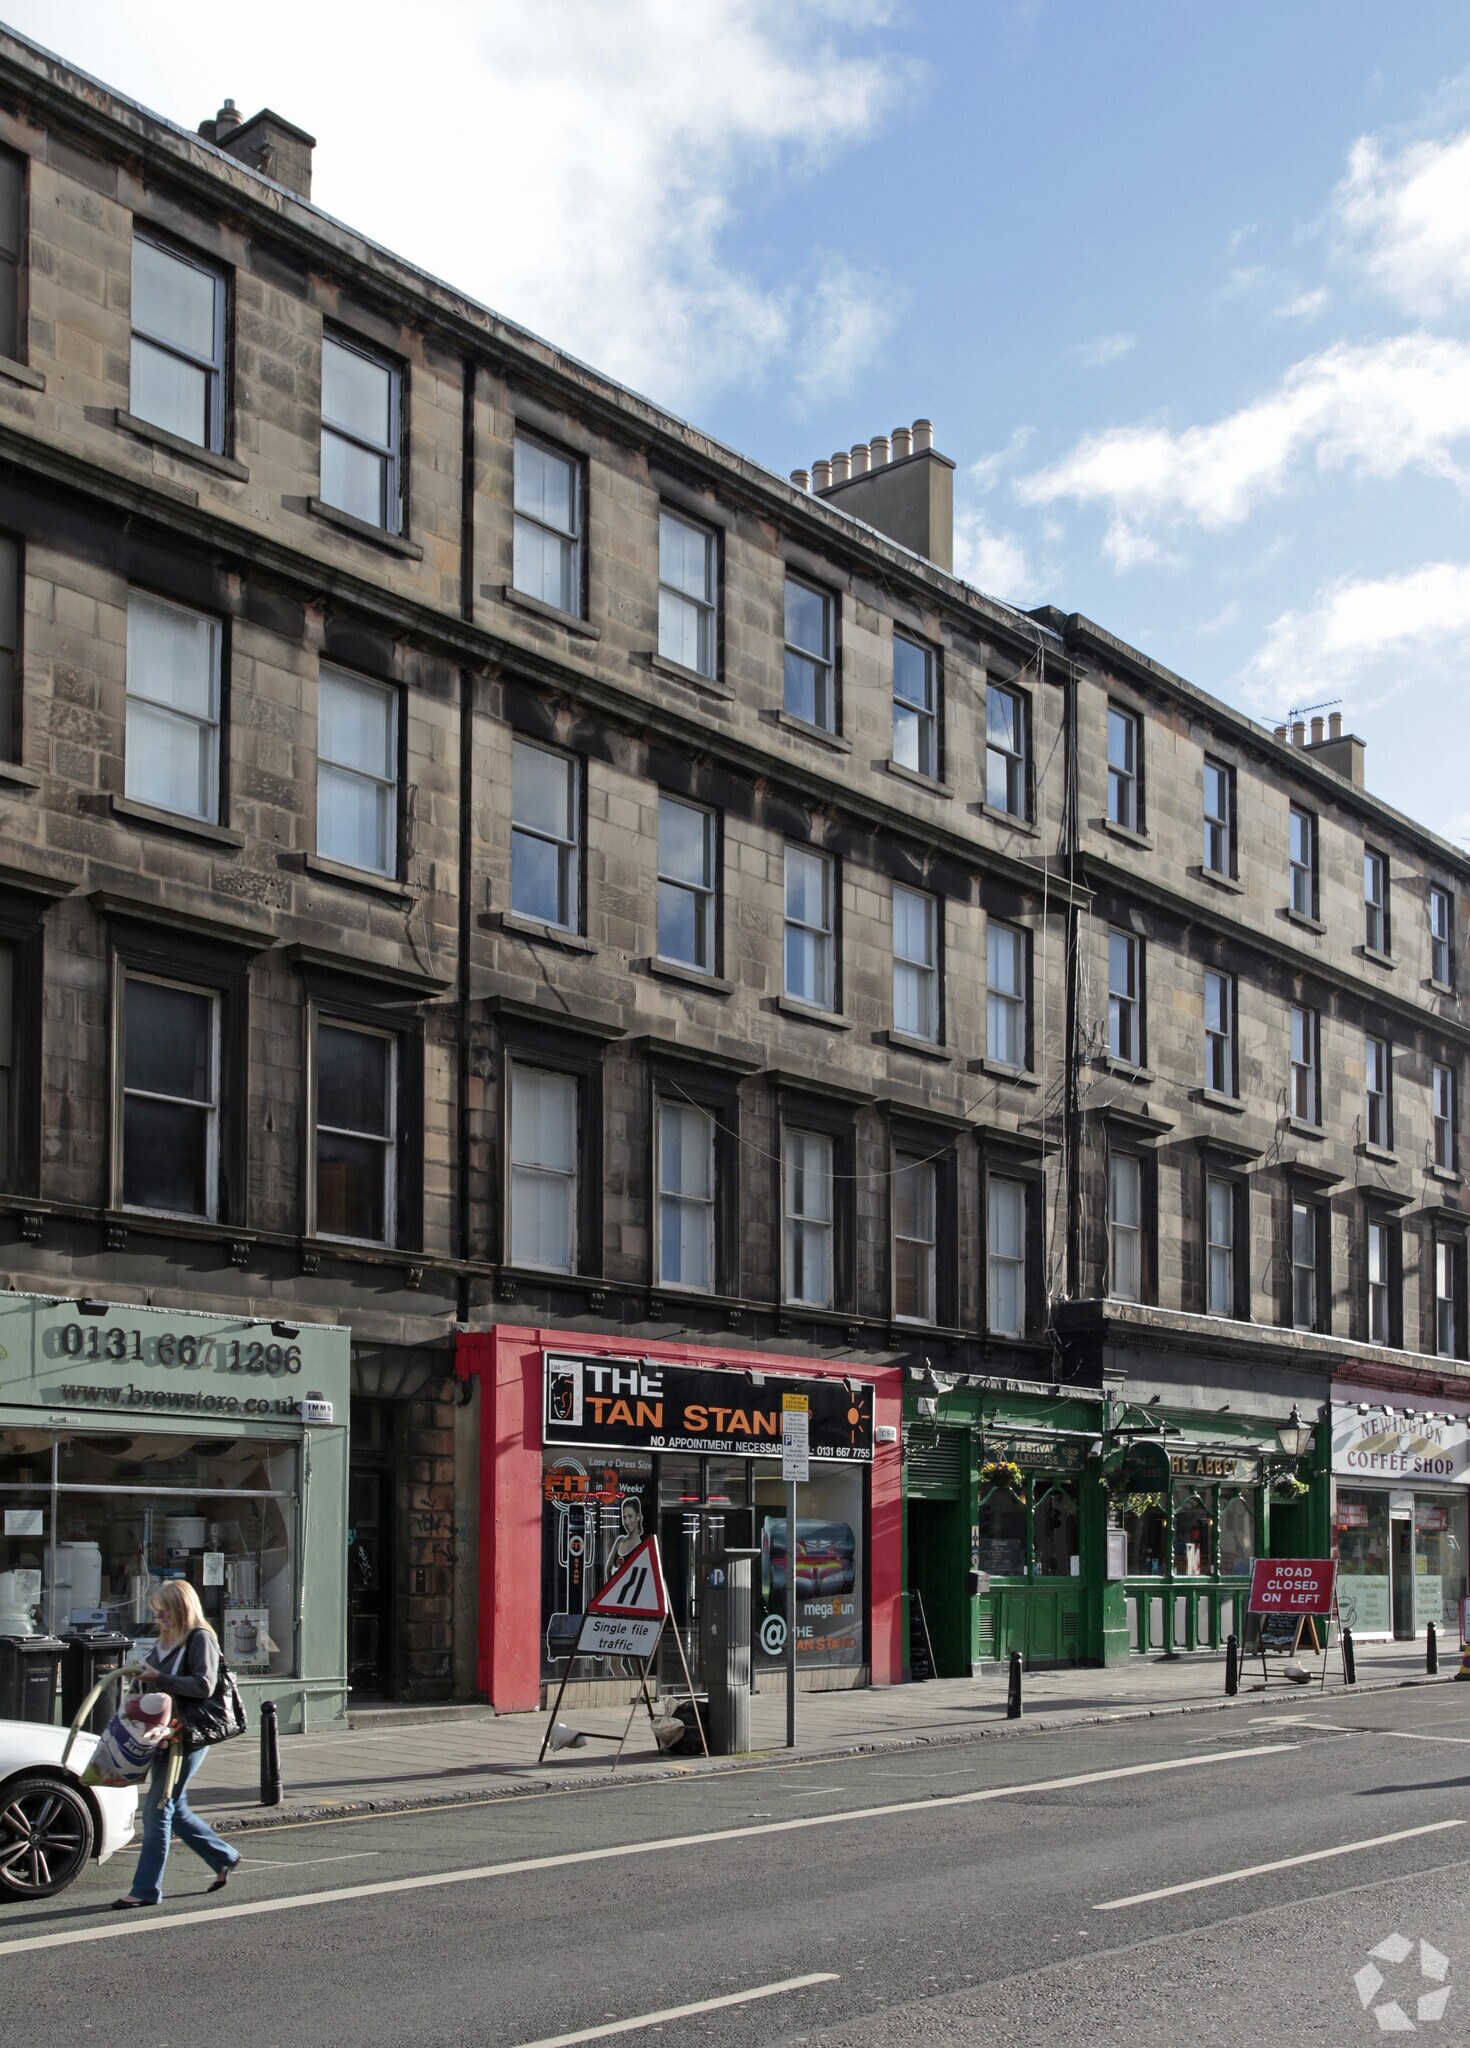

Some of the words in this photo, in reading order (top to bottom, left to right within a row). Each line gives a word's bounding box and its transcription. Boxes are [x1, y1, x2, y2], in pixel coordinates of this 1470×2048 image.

[62, 1323, 144, 1360] 0131
[159, 1333, 217, 1366] 667
[231, 1340, 302, 1374] 1296
[586, 1365, 664, 1398] THE
[61, 1384, 302, 1416] www.brewstore.co.uk
[585, 1397, 663, 1428] TAN
[683, 1404, 783, 1436] STAN
[1361, 1417, 1443, 1445] NEWINGTON
[650, 1436, 665, 1447] NO
[669, 1436, 733, 1451] APPOINTMENT
[735, 1441, 783, 1454] NECESSAR
[816, 1446, 834, 1456] 0131
[836, 1447, 851, 1457] 667
[852, 1448, 871, 1458] 7755
[1015, 1442, 1055, 1453] FESTIVAL
[615, 1459, 636, 1468] Dress
[638, 1460, 653, 1470] Size
[1013, 1453, 1058, 1465] ALEHOUSE
[1170, 1455, 1189, 1473] HE
[1196, 1456, 1239, 1475] ABBEY
[1347, 1450, 1408, 1471] COFFEE
[1414, 1457, 1454, 1475] SHOP
[544, 1475, 590, 1491] FIT
[595, 1482, 603, 1491] in
[600, 1469, 618, 1504] 3
[1275, 1567, 1312, 1577] ROAD
[1267, 1580, 1319, 1590] CLOSED
[1262, 1593, 1281, 1602] ON
[1290, 1594, 1320, 1604] LEFT
[804, 1599, 854, 1618] megaSun
[592, 1621, 627, 1636] Single
[631, 1624, 649, 1636] file
[760, 1614, 788, 1655] @
[598, 1638, 633, 1651] traffic
[795, 1638, 813, 1650] AN
[816, 1638, 857, 1650] STAND
